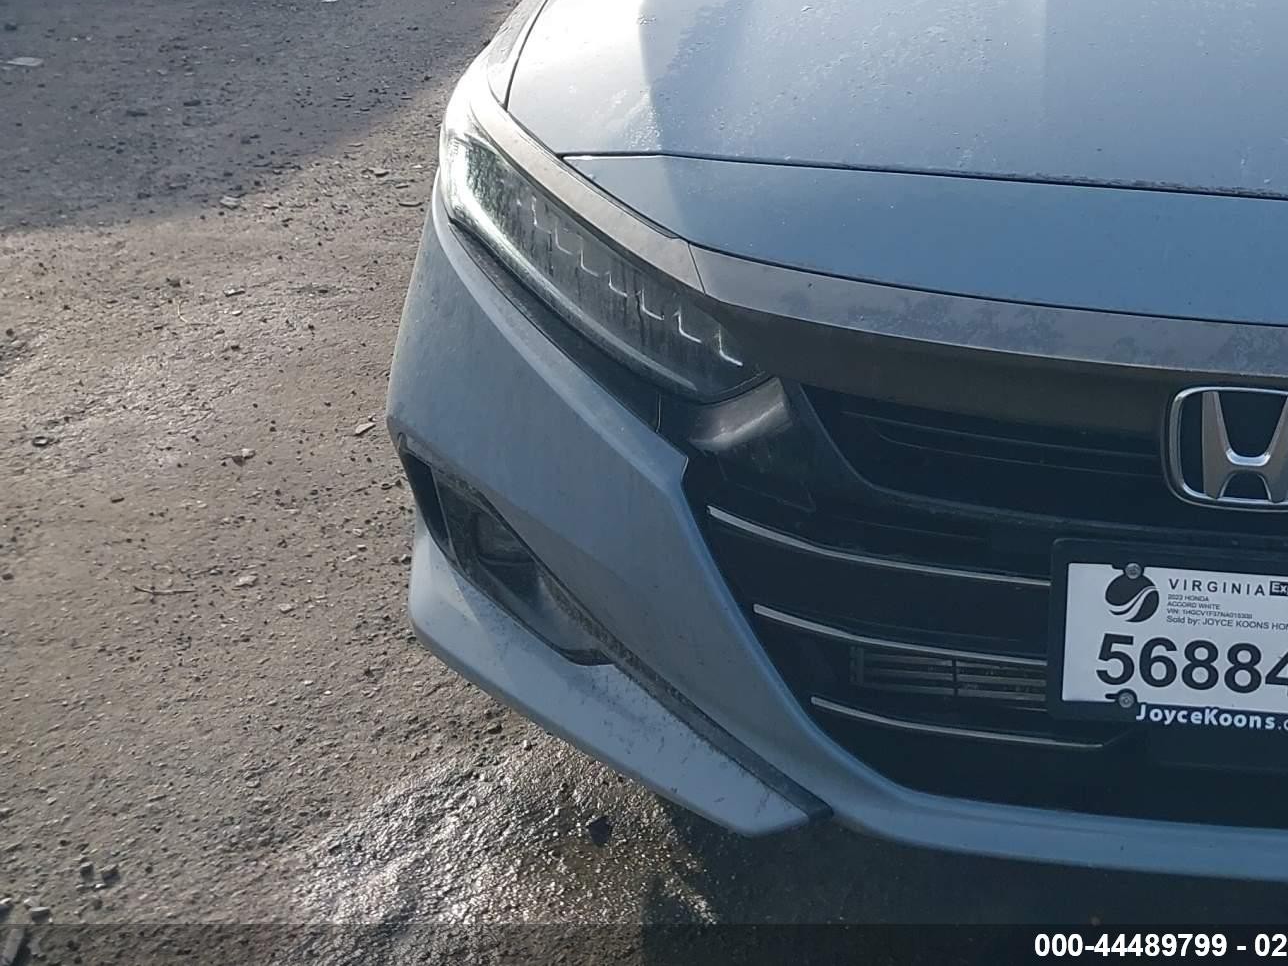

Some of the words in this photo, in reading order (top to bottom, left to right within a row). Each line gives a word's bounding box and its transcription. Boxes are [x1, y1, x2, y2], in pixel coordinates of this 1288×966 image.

[1168, 578, 1266, 597] VIRGINIA
[1167, 601, 1197, 609] ACCORD
[1199, 603, 1221, 611] WHITE
[1167, 615, 1186, 624] Sold
[1188, 617, 1201, 627] by:
[1203, 618, 1234, 628] JOYCE
[1236, 620, 1270, 631] KOONS
